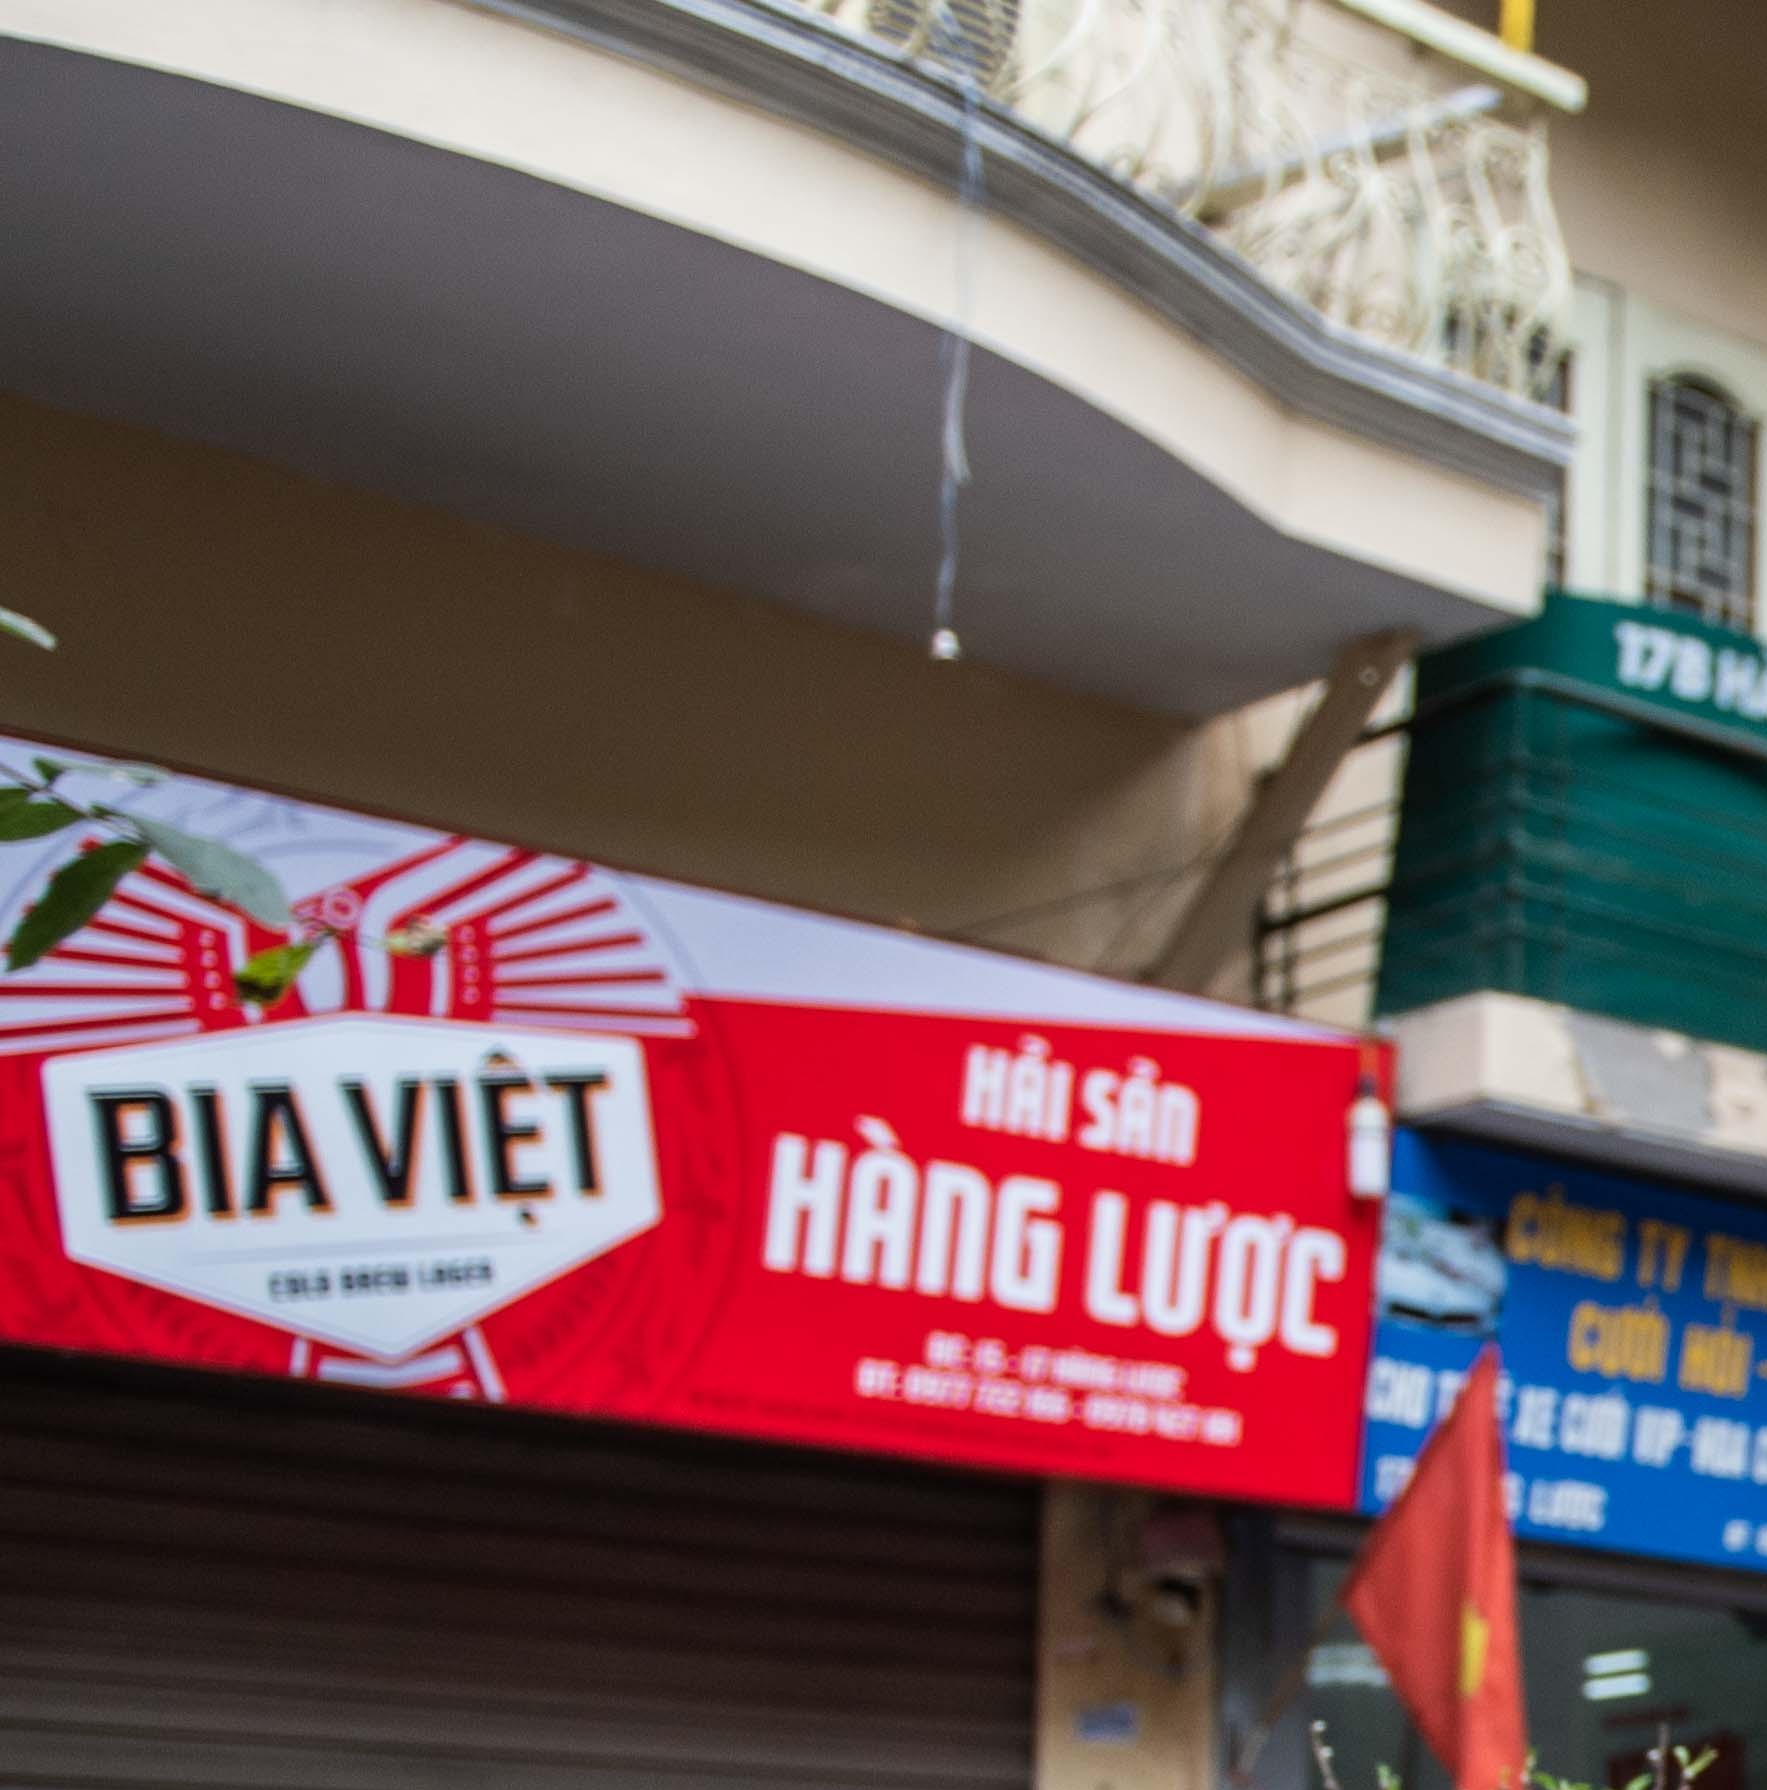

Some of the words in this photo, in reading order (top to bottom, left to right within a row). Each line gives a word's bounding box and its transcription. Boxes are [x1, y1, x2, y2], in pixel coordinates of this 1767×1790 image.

[1614, 620, 1711, 701] 17B
[86, 1076, 336, 1229] BIA
[338, 1046, 612, 1230] VIỆT
[961, 1034, 1074, 1143] HẢI
[1075, 1055, 1201, 1167] SẢN
[763, 1115, 1064, 1315] HÀNG
[1084, 1189, 1347, 1372] LƯỢC
[1636, 1216, 1691, 1295] TY
